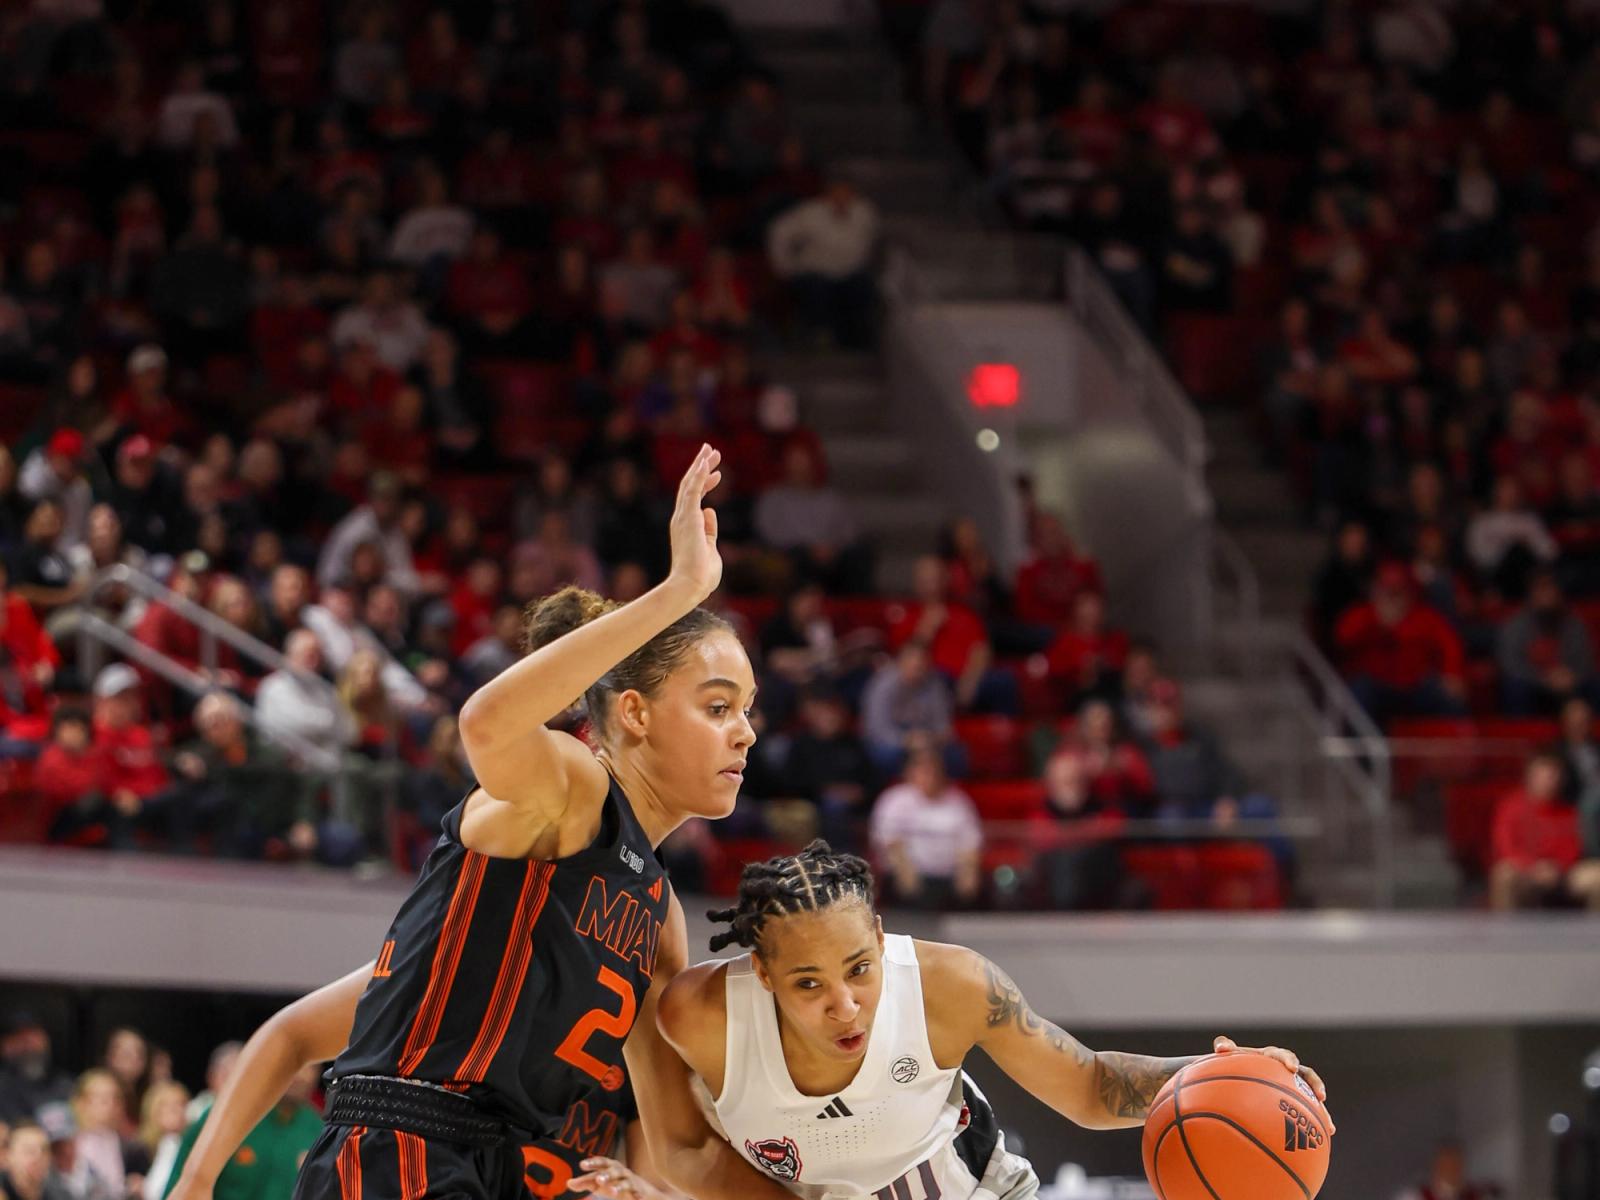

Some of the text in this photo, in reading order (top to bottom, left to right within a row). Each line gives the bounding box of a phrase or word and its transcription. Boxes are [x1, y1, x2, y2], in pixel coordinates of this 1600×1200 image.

[576, 875, 662, 981] MIA
[554, 965, 637, 1089] 2
[894, 1063, 918, 1074] ACC
[1279, 1099, 1323, 1146] adidas
